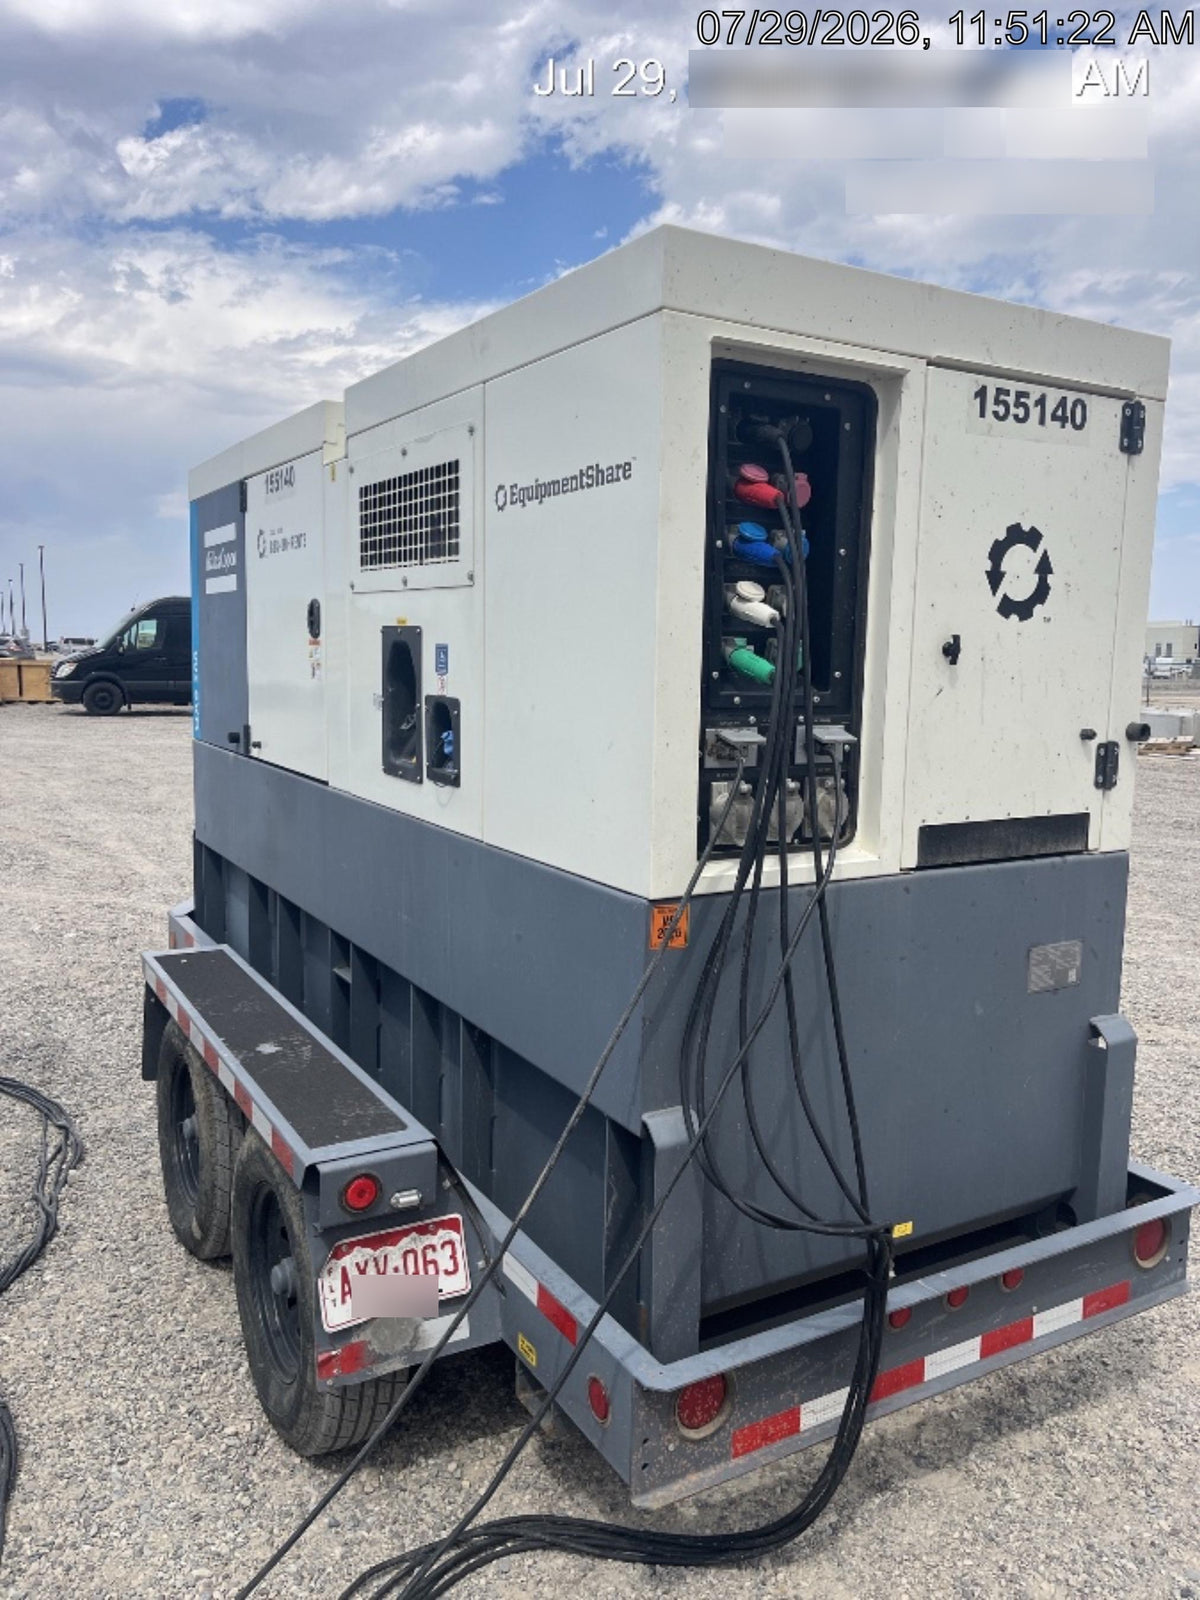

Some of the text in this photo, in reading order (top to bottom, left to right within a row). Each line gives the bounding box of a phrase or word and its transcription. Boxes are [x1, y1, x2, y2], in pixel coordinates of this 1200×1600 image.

[974, 384, 1088, 431] 155140
[265, 465, 295, 495] 155140
[509, 461, 632, 508] EquipmentShare
